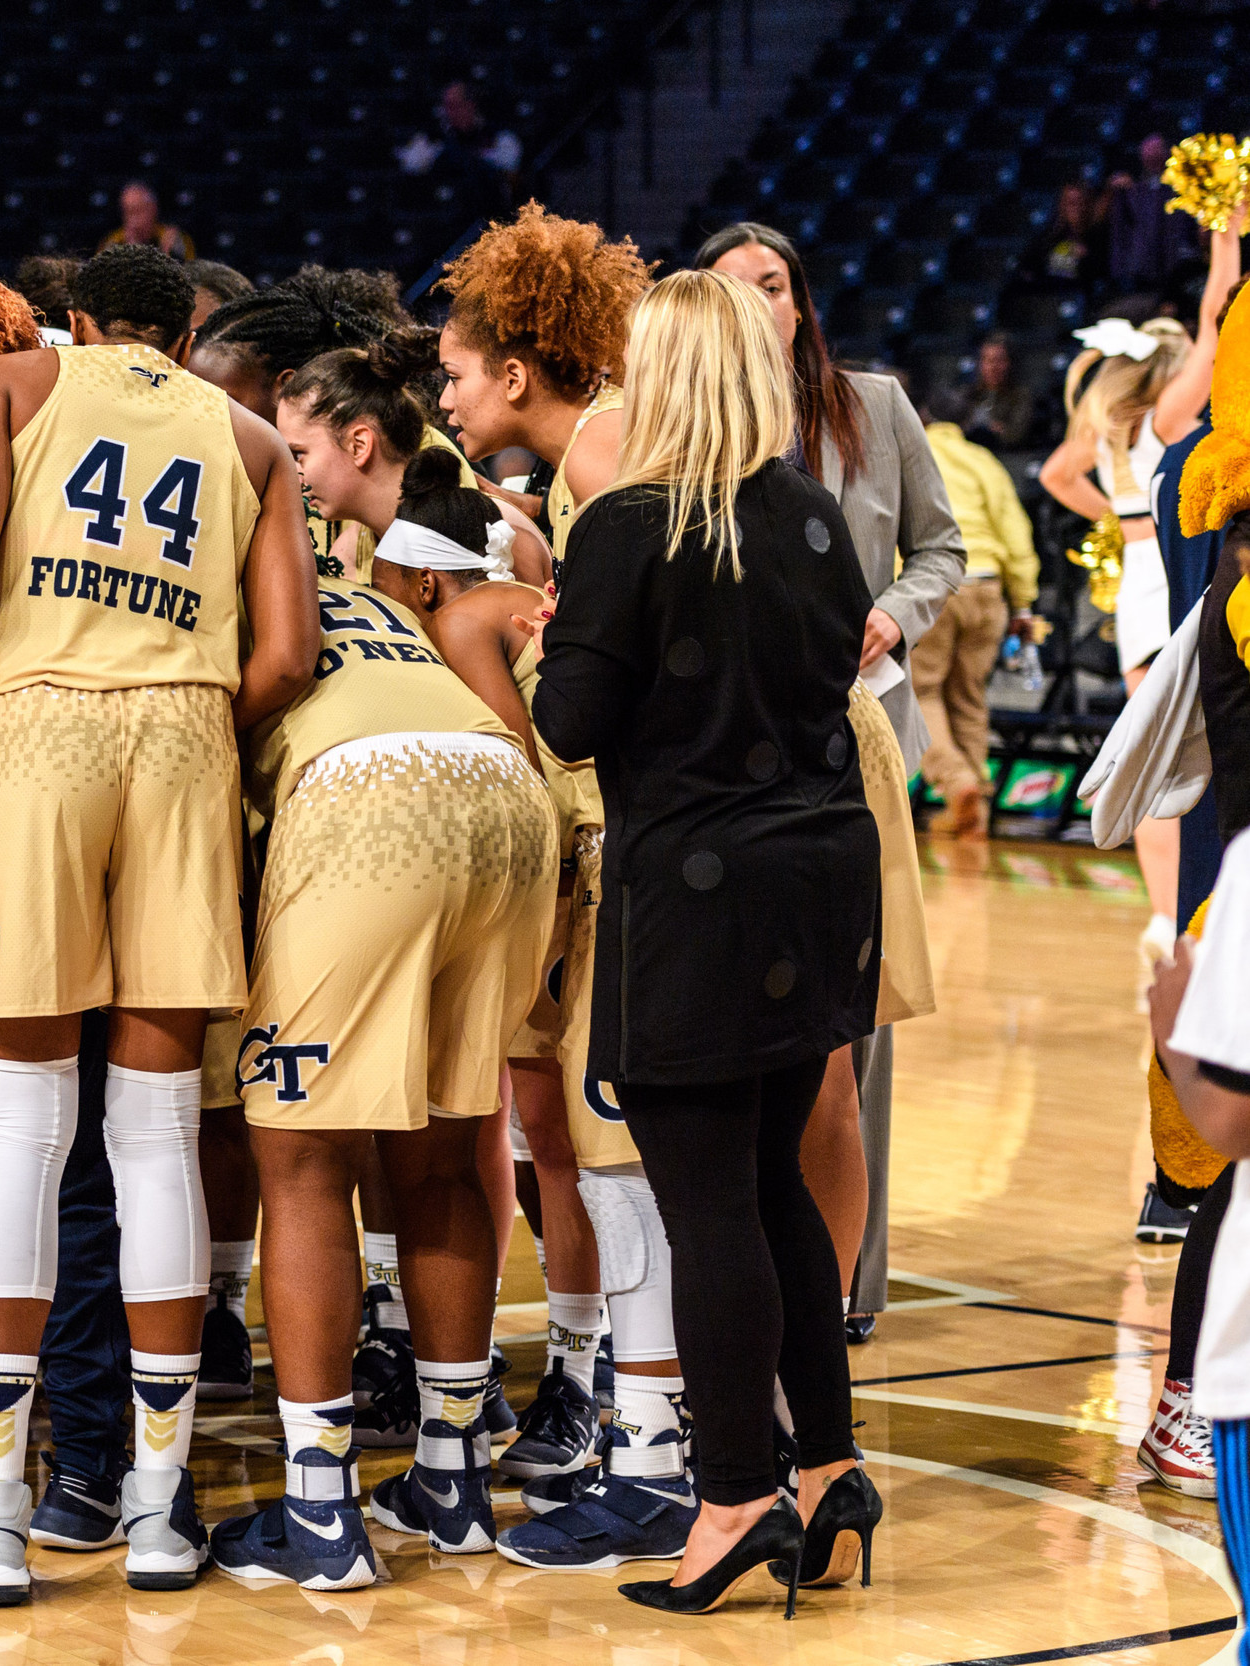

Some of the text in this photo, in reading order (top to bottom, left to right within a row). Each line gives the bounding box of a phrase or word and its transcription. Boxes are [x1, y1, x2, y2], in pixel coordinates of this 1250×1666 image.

[61, 435, 204, 571] 44
[28, 556, 202, 632] FORTUNE
[318, 589, 422, 640] 21
[313, 639, 447, 681] O'NEI
[235, 1022, 330, 1104] GT
[548, 1320, 593, 1352] GT
